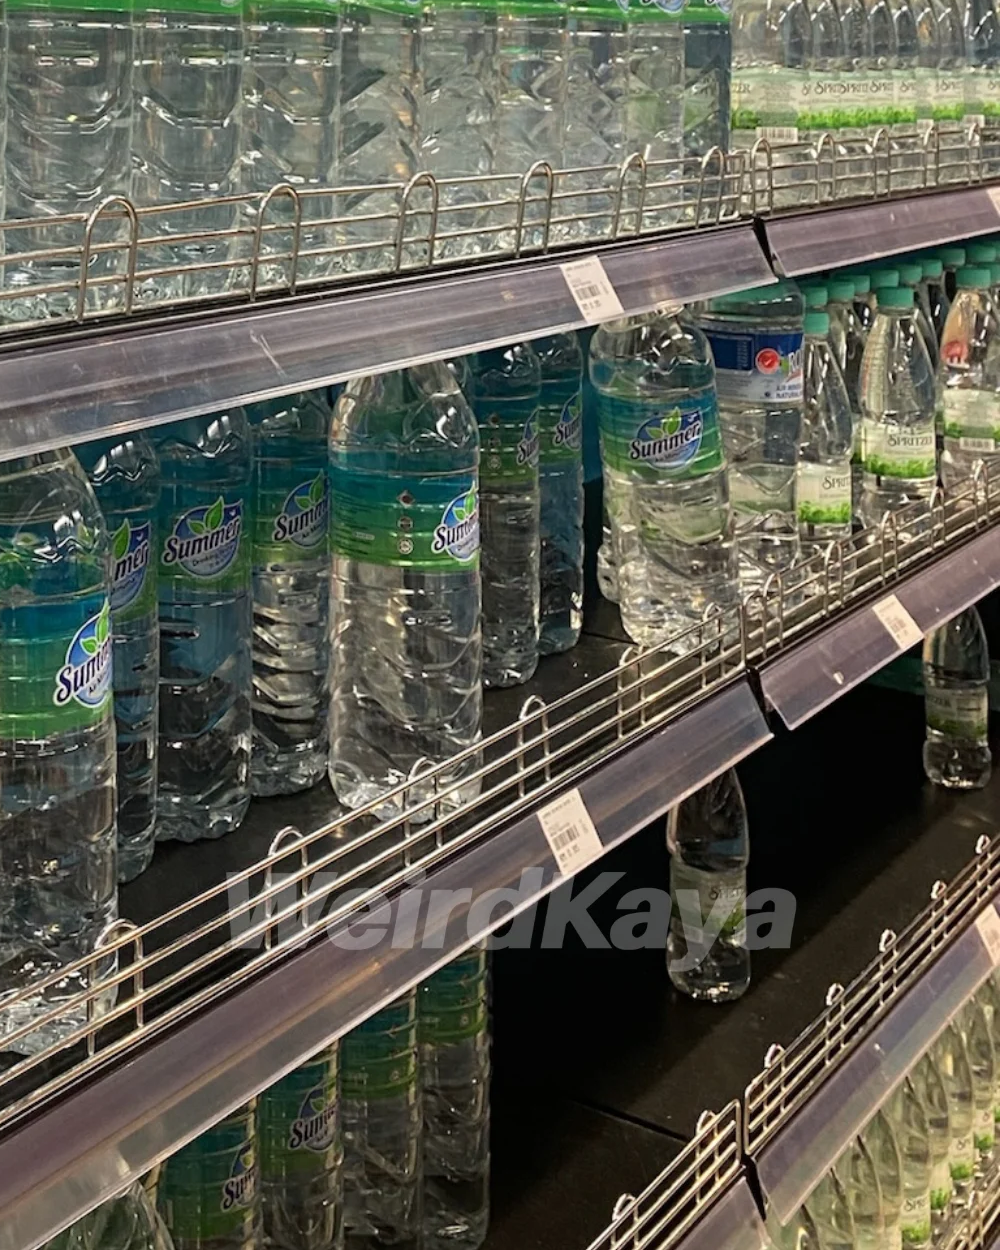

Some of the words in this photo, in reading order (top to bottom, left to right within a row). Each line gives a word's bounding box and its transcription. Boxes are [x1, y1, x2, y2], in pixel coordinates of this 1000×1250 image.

[630, 421, 701, 460] Summer
[114, 540, 148, 581] mer
[163, 518, 241, 564] Summer
